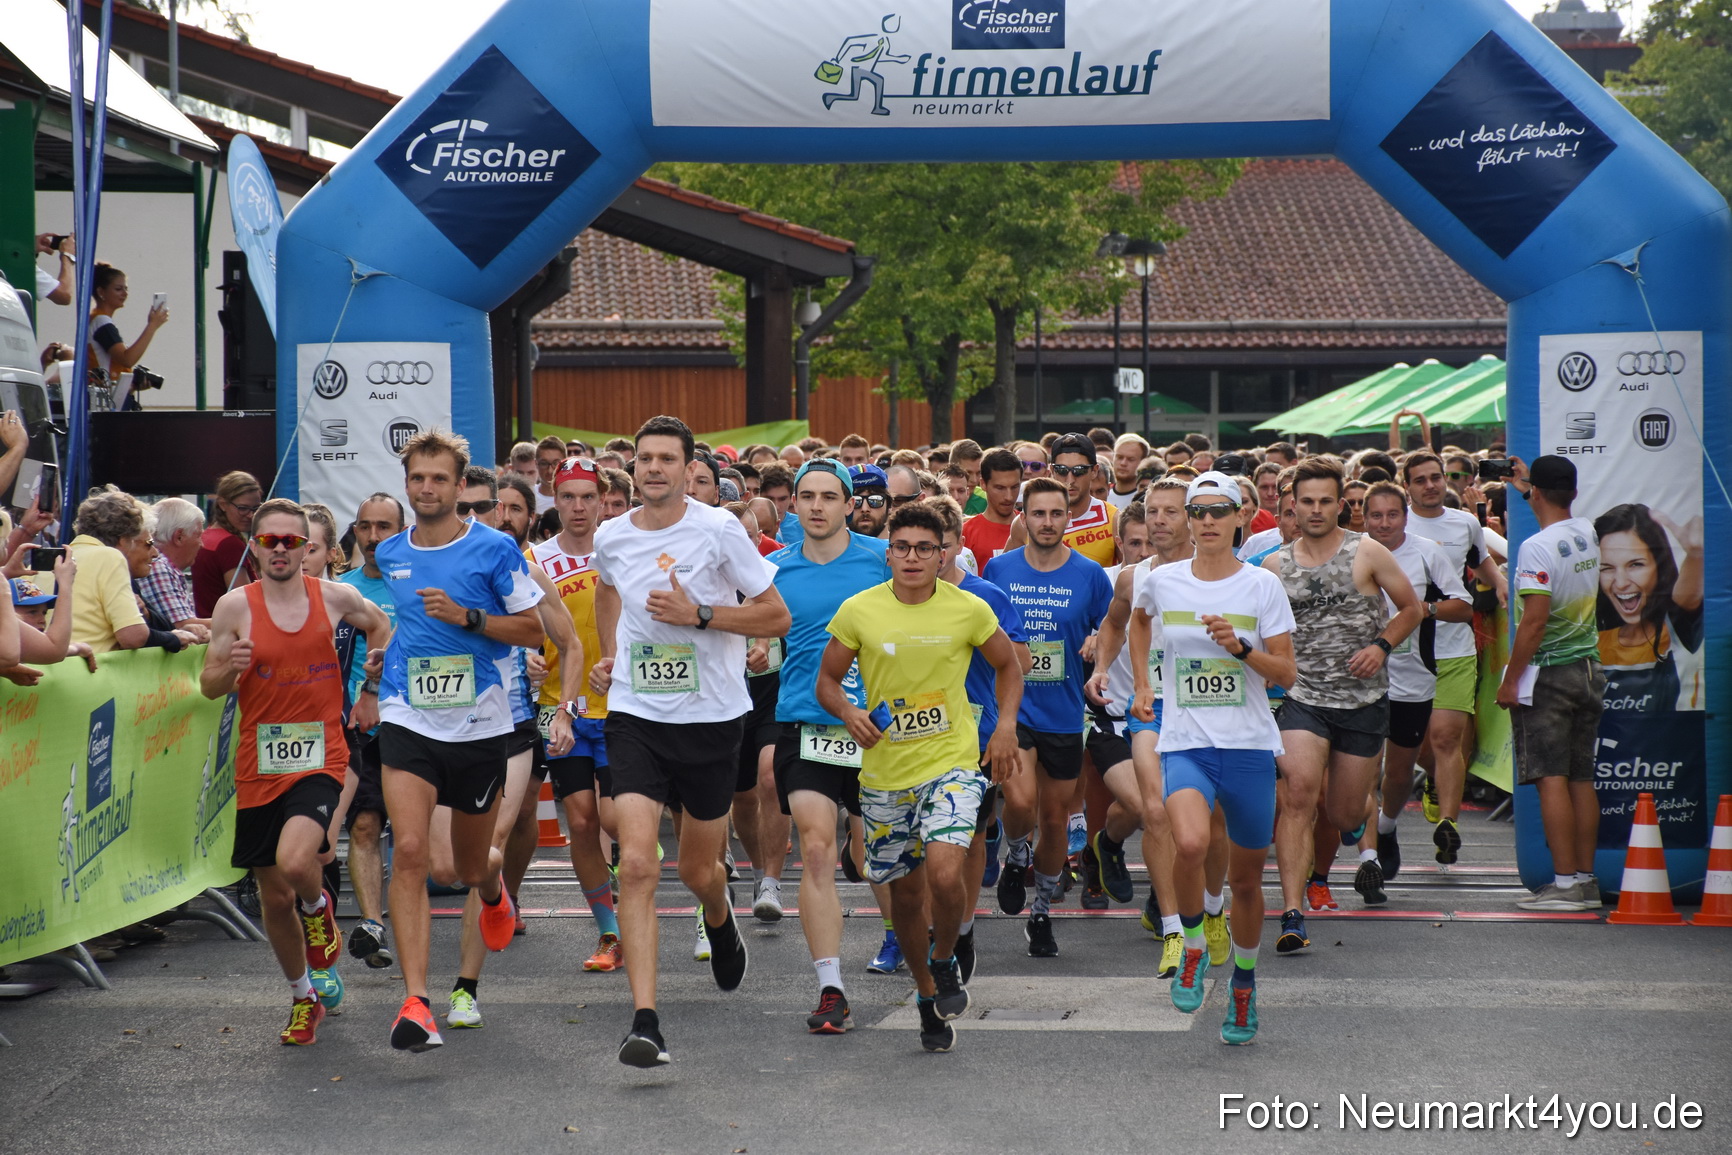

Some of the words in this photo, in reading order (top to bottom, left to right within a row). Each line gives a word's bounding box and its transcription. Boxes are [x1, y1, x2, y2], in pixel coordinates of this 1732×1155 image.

[976, 8, 1058, 25] Fischer
[984, 26, 1052, 34] AUTOMOBILE
[912, 49, 1163, 96] firmenlauf
[912, 99, 1015, 115] neumarkt
[1429, 130, 1465, 150] und
[1470, 124, 1506, 143] das
[432, 142, 566, 168] Fischer
[1476, 148, 1531, 173] fährt
[1535, 141, 1580, 158] mit!
[443, 171, 554, 183] AUTOMOBILE
[1121, 371, 1139, 390] WC
[1619, 382, 1649, 391] Audi
[369, 391, 398, 400] Audi
[1643, 420, 1668, 440] FIAT
[311, 452, 358, 461] SEAT
[1556, 445, 1607, 455] SEAT
[1075, 528, 1113, 546] BÖGL
[1574, 557, 1598, 573] CREW
[1009, 582, 1036, 593] Wenn
[1037, 586, 1048, 594] es
[1049, 584, 1073, 596] beim
[1010, 595, 1070, 608] Hausverkauf
[1024, 608, 1053, 620] richtig
[1023, 620, 1057, 631] AUFEN
[1029, 634, 1046, 643] soll!
[308, 662, 338, 675] Folien
[638, 661, 689, 680] 1332
[415, 673, 465, 694] 1077
[1184, 675, 1236, 693] 1093
[1603, 694, 1653, 713] scher
[892, 707, 942, 732] 1269
[265, 740, 315, 760] 1807
[809, 736, 858, 756] 1739
[1594, 756, 1683, 778] scher
[1593, 780, 1675, 790] UTOMOBILE
